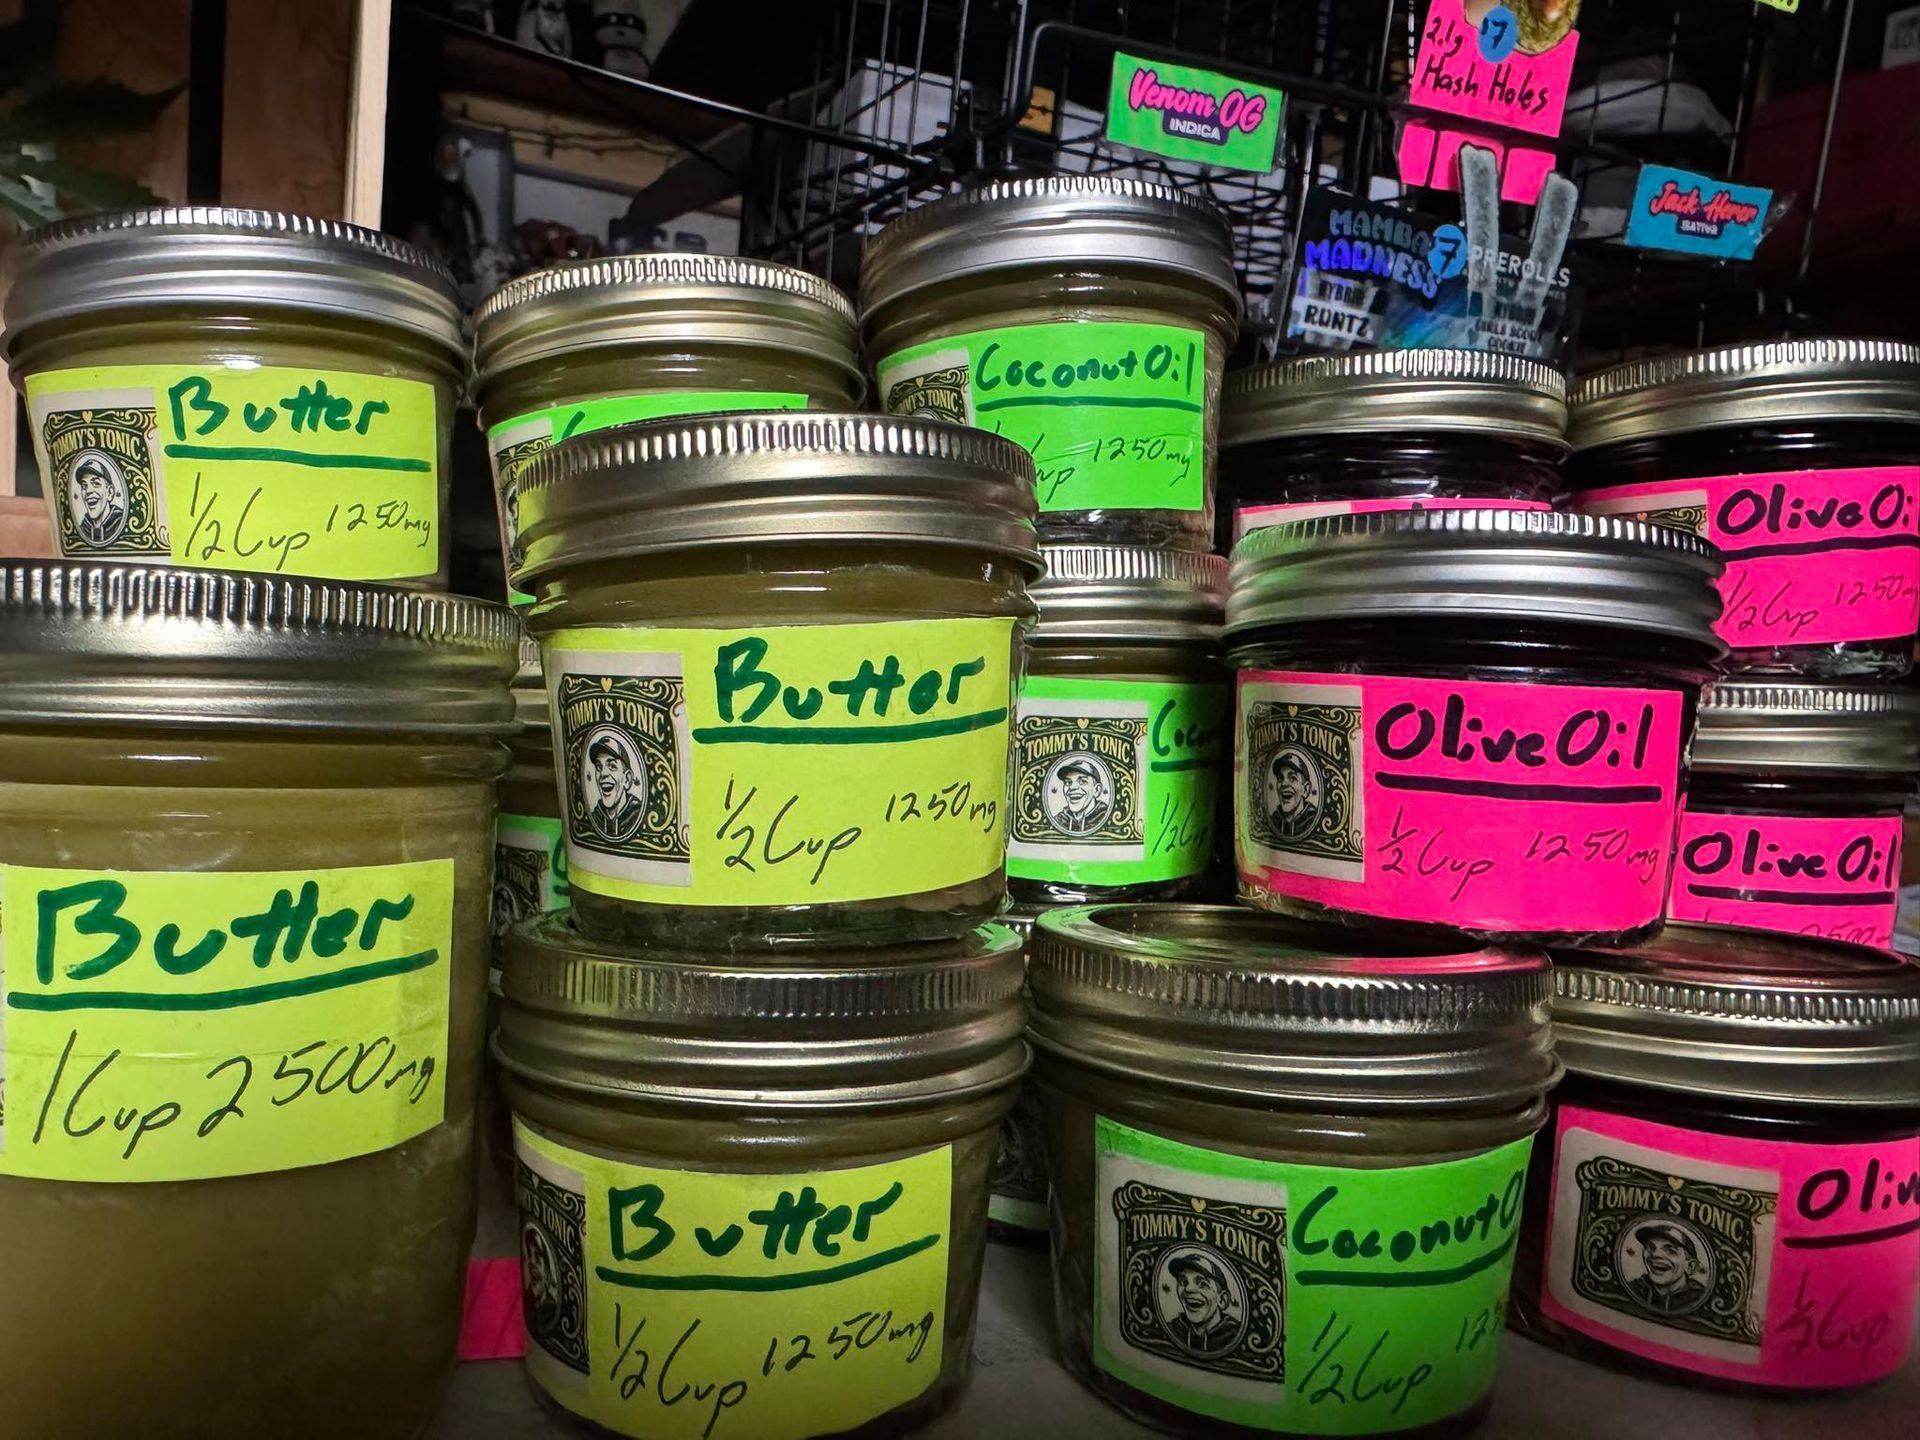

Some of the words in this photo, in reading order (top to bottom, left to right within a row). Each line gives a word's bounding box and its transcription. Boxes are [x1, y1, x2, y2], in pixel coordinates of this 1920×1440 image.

[1129, 68, 1217, 117] Venom
[1219, 89, 1267, 133] OG
[1421, 54, 1478, 97] Hash
[1488, 63, 1549, 115] Holes
[1169, 118, 1221, 140] INDICA
[1304, 238, 1439, 299] MADNESS
[1438, 236, 1461, 275] 7
[1304, 304, 1371, 338] RUNTZ
[975, 342, 1138, 392] Coconut
[1144, 342, 1196, 395] Oil
[167, 376, 389, 441] Butter
[927, 389, 958, 412] TONIC
[52, 428, 96, 466] TOMMY'S
[97, 428, 141, 460] TONIC
[1093, 437, 1192, 487] 1250mg
[185, 472, 225, 560] 1/2
[234, 487, 310, 569] Cup
[326, 501, 431, 548] 1250mg
[1716, 483, 1865, 535] Olive
[1869, 483, 1920, 530] Oi
[1762, 580, 1820, 638] Cup
[714, 636, 985, 723] Butter
[567, 699, 615, 733] TOMMY'S
[617, 700, 665, 743] TONIC
[1025, 733, 1089, 763] TOMMY'S
[1091, 734, 1131, 764] TONIC
[1253, 722, 1298, 753] TOMMY'S
[1300, 723, 1343, 760] TONIC
[1374, 693, 1547, 768] Olive
[1556, 704, 1654, 770] Oil
[716, 773, 756, 873] 1/2
[764, 794, 862, 885] Cup
[886, 781, 996, 833] 1250mg
[1375, 806, 1418, 875] 1/2
[1418, 829, 1497, 901] Cup
[1525, 828, 1660, 885] 1250mg
[1682, 829, 1828, 879] Olive
[1837, 833, 1898, 889] Oil
[37, 880, 414, 985] Butter
[33, 1029, 77, 1144] 1
[63, 1049, 181, 1160] Cup
[196, 1035, 435, 1138] 2500mg
[1597, 1184, 1683, 1214] TOMMY'S
[1687, 1198, 1745, 1242] TONIC
[1797, 1157, 1920, 1221] Oliv
[541, 1200, 576, 1255] TONIC
[608, 1181, 903, 1261] Butter
[1130, 1213, 1206, 1242] TOMMY'S
[1211, 1221, 1272, 1268] TONIC
[1291, 1185, 1500, 1262] Coconut
[1817, 1281, 1890, 1370] Cup
[609, 1302, 646, 1400] 1/2
[658, 1319, 748, 1440] Cup
[762, 1311, 934, 1377] 1250mg
[1296, 1310, 1352, 1405] 1/2
[1351, 1328, 1433, 1415] Cup
